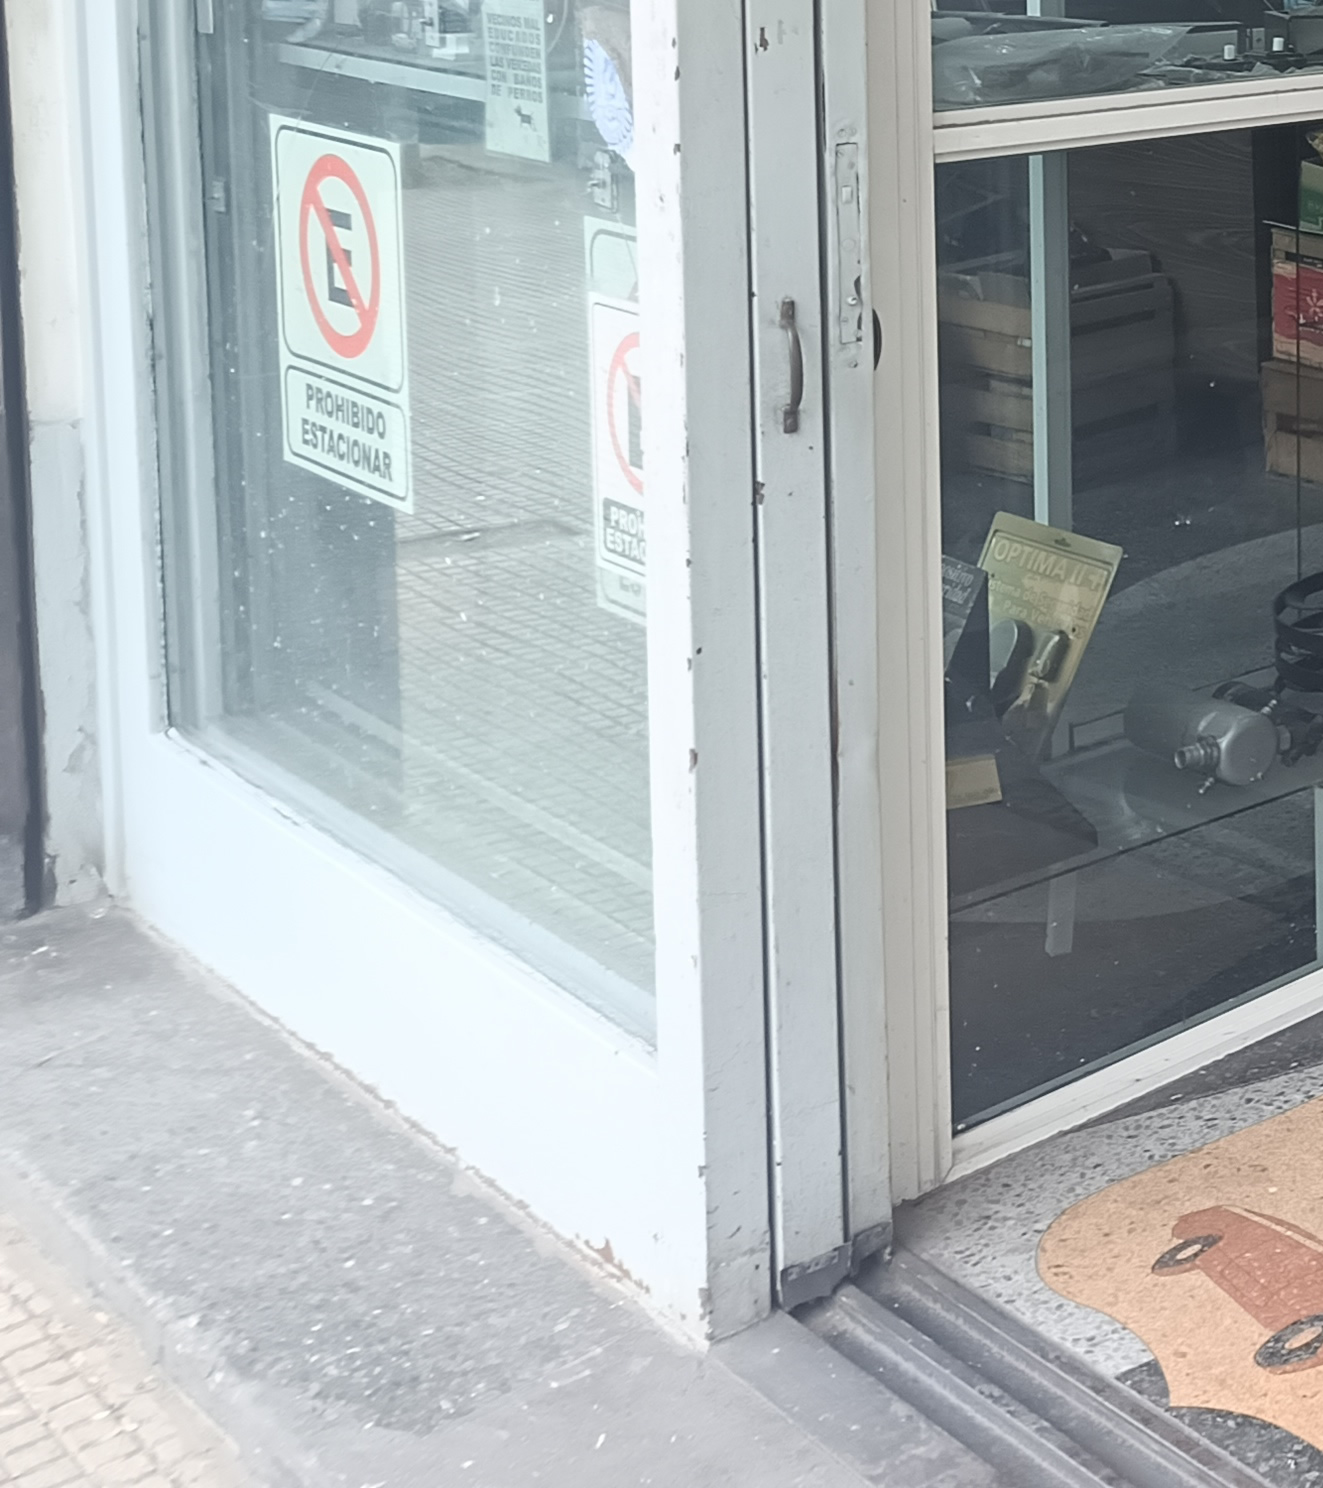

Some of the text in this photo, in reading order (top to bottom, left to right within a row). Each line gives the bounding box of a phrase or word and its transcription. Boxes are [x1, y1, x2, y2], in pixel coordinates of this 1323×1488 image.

[305, 383, 386, 440] PROHIBIDO
[301, 417, 393, 482] ESTACIONAR
[993, 538, 1067, 582] OPTIMA
[1003, 599, 1029, 618] Para
